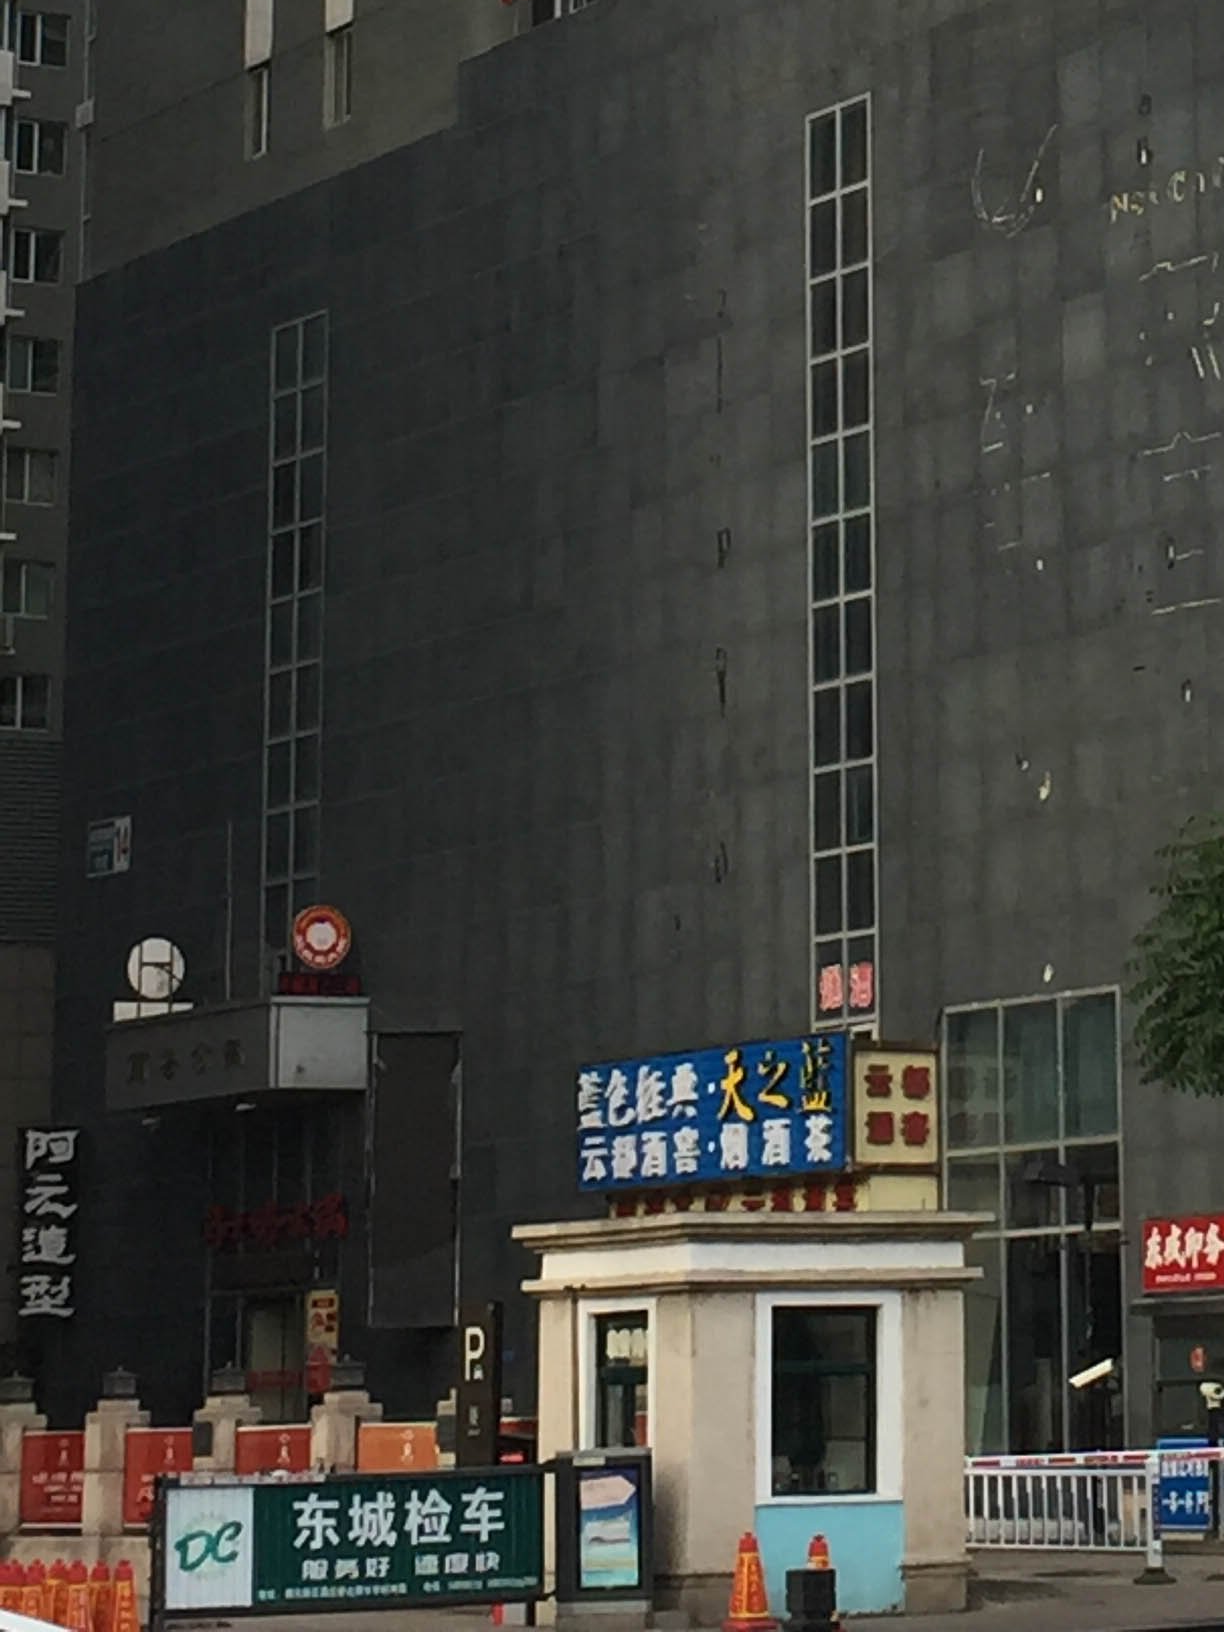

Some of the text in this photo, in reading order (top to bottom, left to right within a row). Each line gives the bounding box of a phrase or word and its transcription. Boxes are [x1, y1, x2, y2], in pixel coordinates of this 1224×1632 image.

[465, 1325, 486, 1382] P
[292, 1486, 506, 1550] 东城检车
[174, 1520, 244, 1574] DC
[302, 1551, 501, 1582] 服务好 速度快
